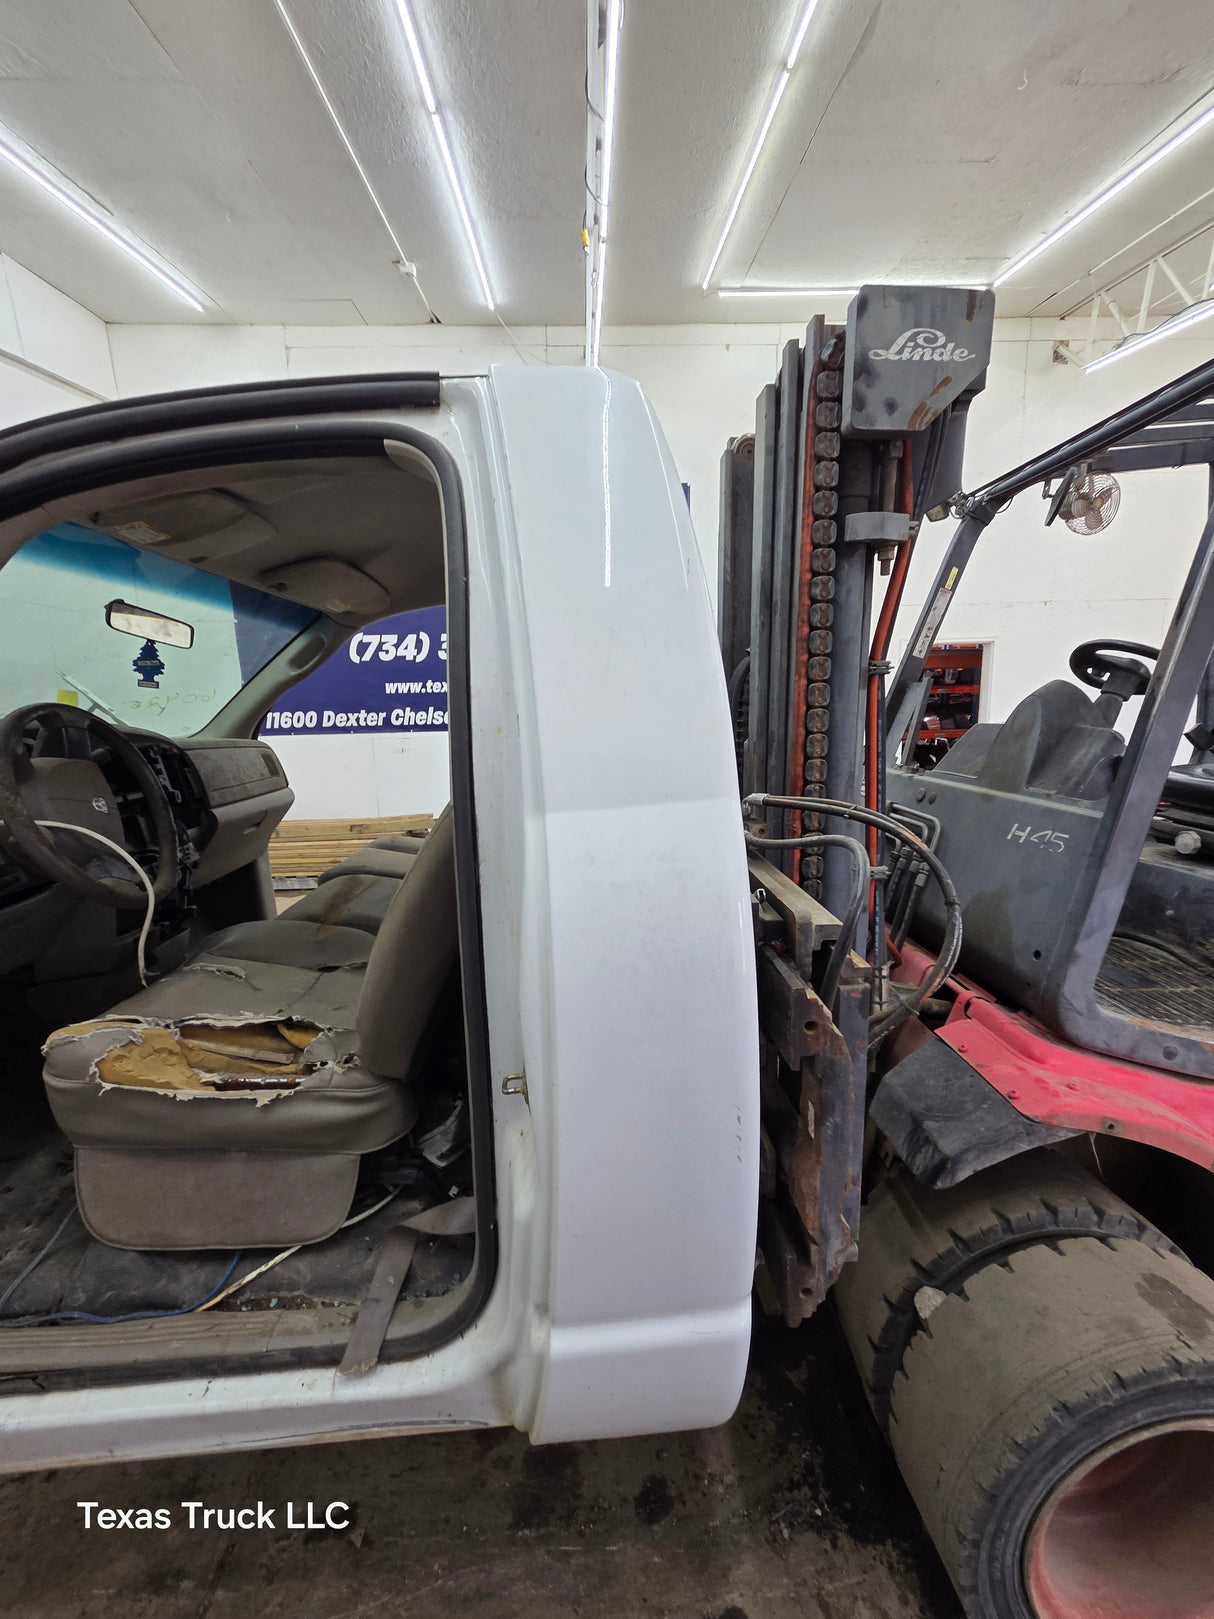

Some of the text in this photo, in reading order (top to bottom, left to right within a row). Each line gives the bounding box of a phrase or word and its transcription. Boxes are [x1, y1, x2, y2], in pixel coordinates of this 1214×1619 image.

[868, 327, 976, 362] Linde
[349, 631, 430, 664] (734)
[265, 711, 318, 730] 11600
[322, 710, 386, 728] Dexter
[1006, 823, 1070, 853] H45
